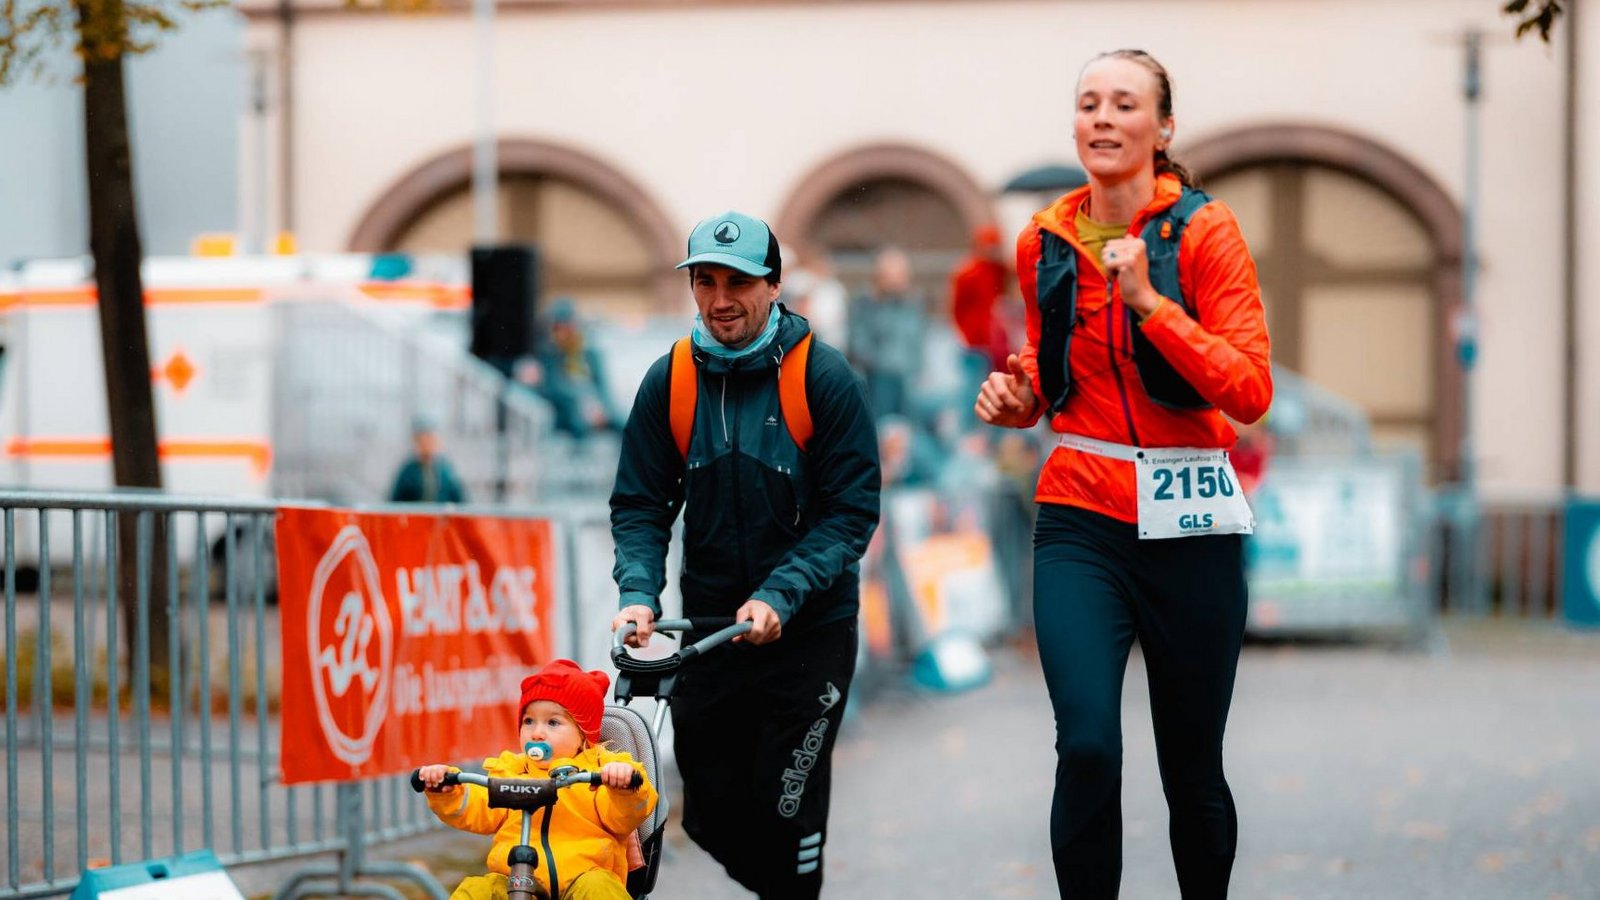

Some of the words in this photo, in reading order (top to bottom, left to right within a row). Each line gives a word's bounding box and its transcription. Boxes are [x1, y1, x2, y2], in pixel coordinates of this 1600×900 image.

[1153, 466, 1234, 501] 2150
[778, 717, 830, 818] adidas
[500, 785, 542, 794] PUKY
